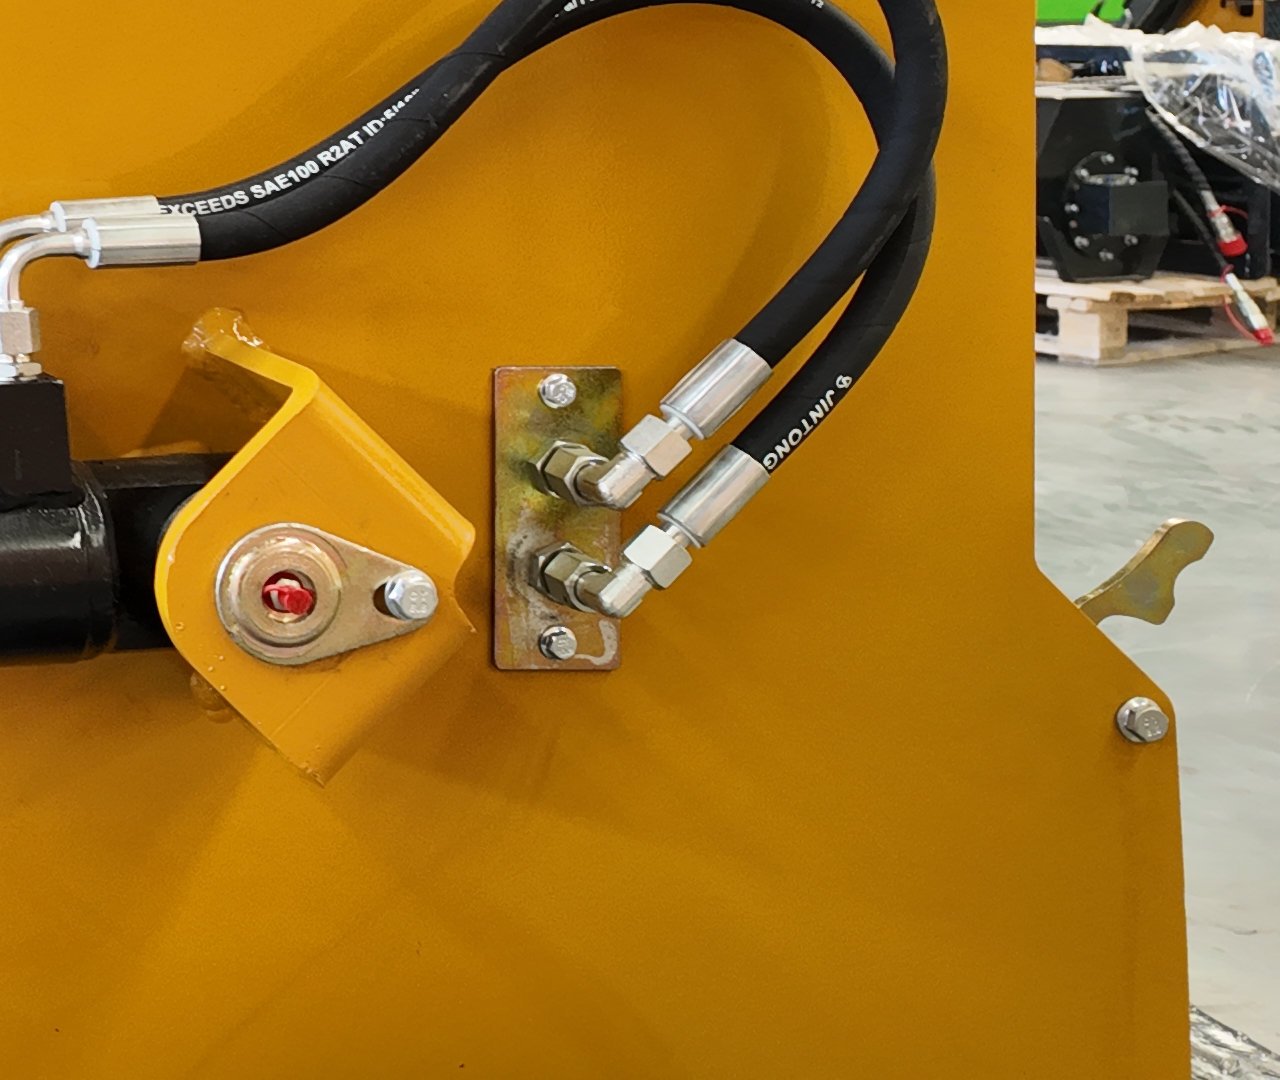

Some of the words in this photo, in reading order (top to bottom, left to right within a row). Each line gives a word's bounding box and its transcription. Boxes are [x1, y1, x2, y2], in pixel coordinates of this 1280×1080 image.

[159, 190, 250, 217] EXCEEDS
[249, 159, 320, 200] SAE100
[317, 130, 365, 167] R2AT
[762, 389, 835, 470] JINTONG
